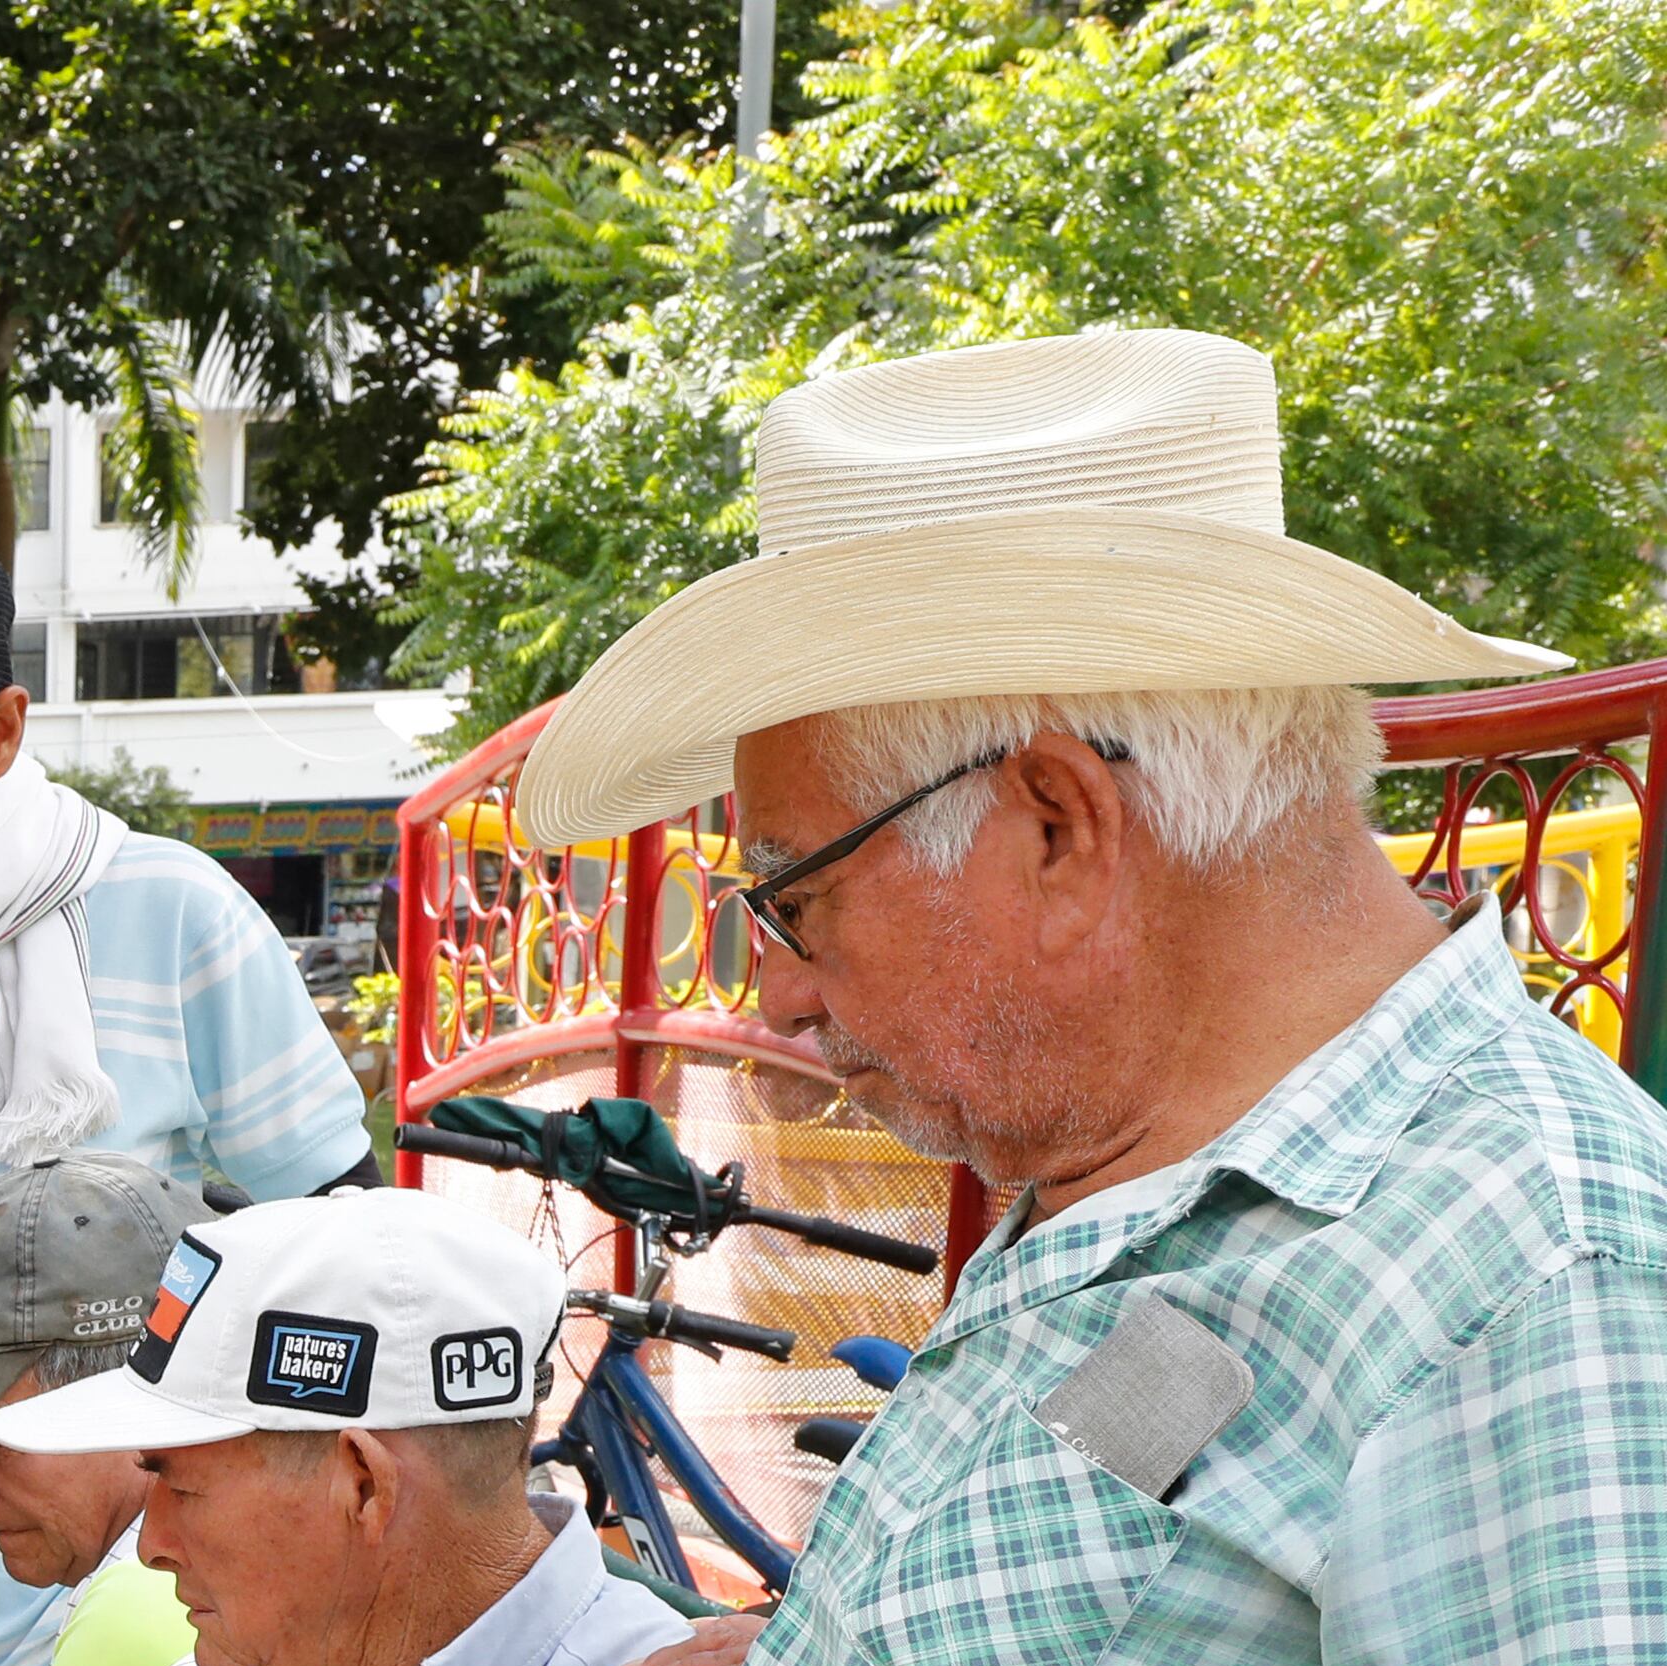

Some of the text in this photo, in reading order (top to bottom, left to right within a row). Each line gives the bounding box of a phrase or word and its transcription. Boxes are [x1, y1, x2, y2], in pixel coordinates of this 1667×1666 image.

[73, 1296, 143, 1319] POLO
[74, 1314, 142, 1336] CLUB
[284, 1335, 347, 1360] nature's
[279, 1352, 343, 1384] bakery
[446, 1339, 512, 1388] PPG
